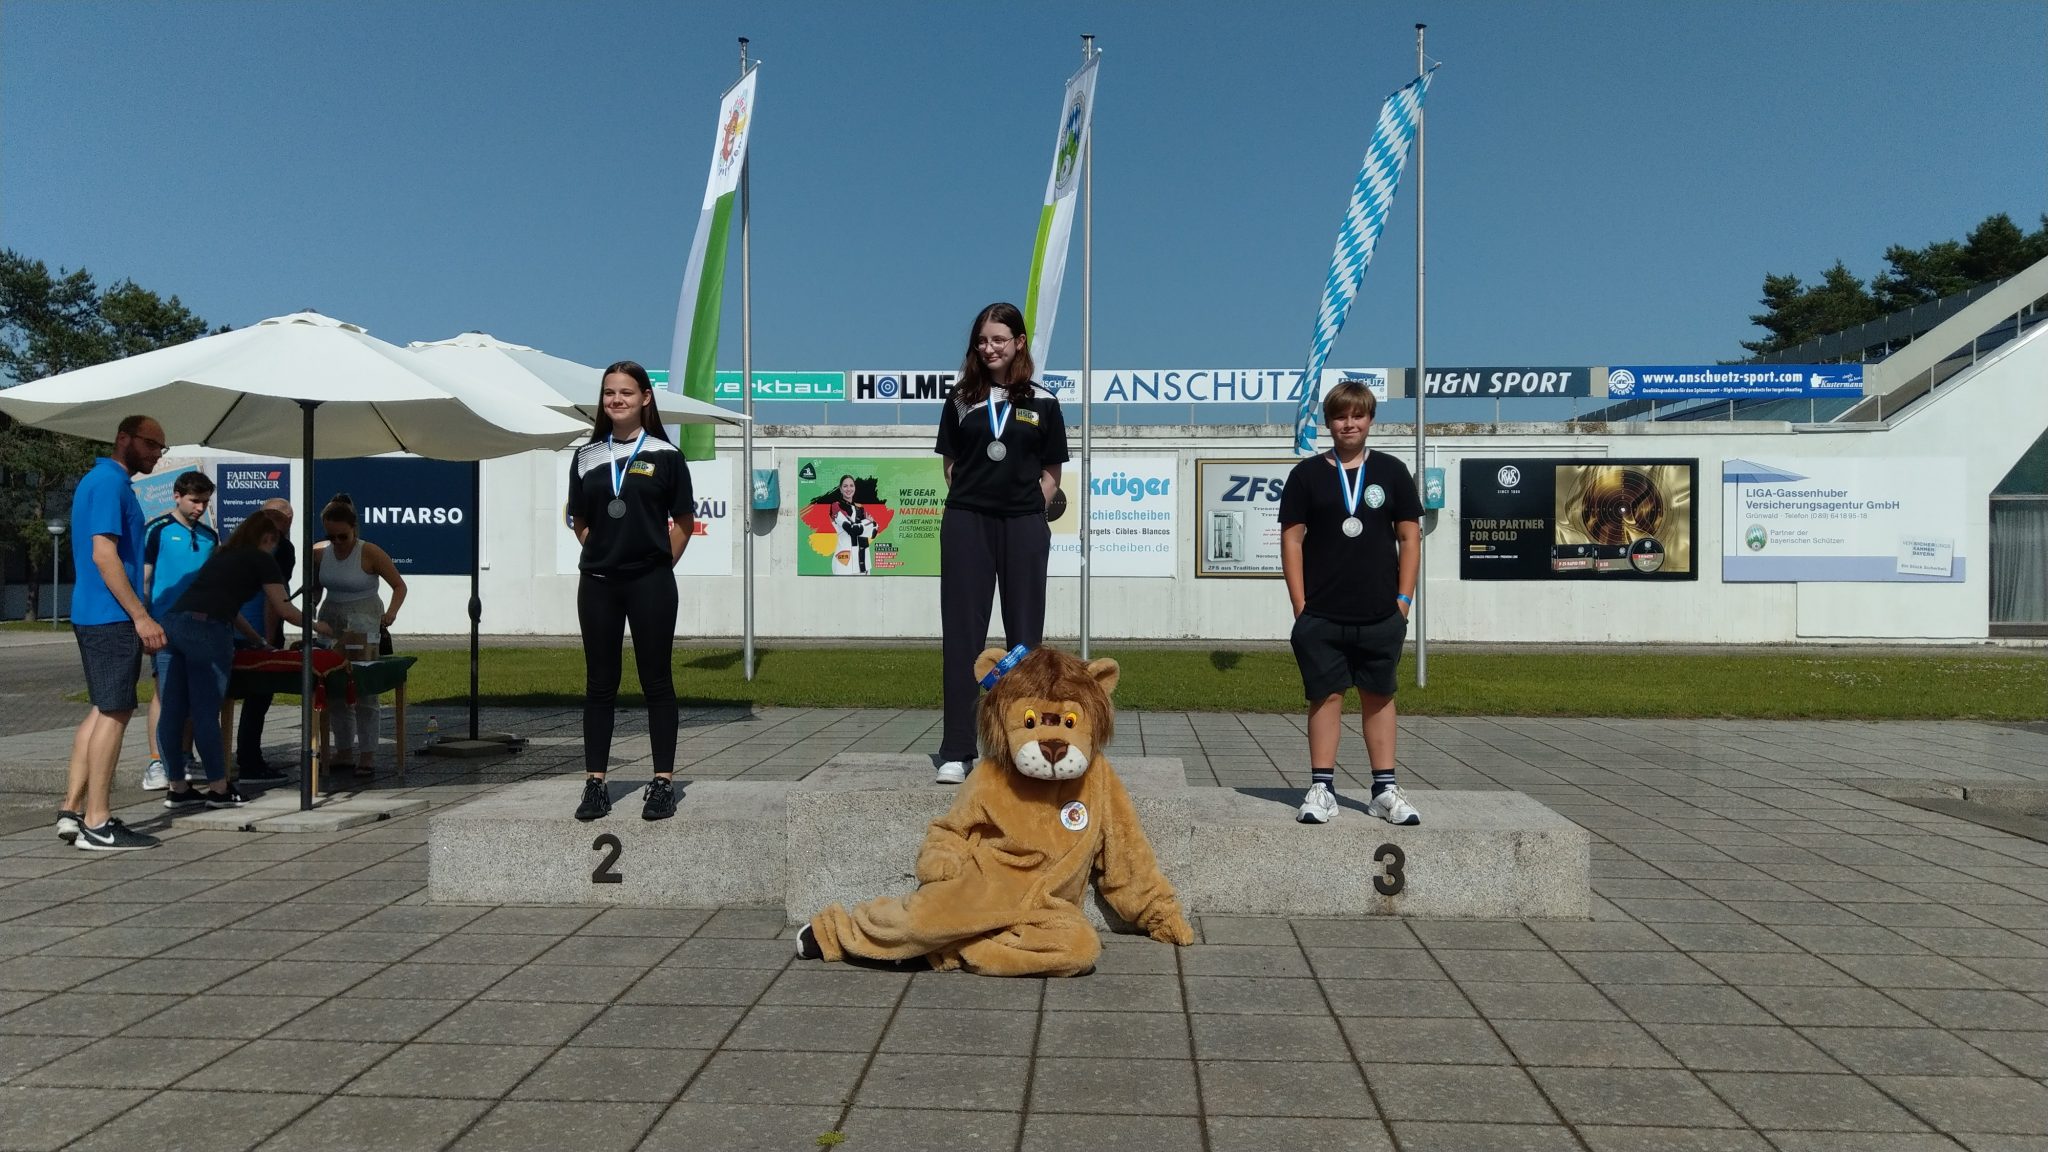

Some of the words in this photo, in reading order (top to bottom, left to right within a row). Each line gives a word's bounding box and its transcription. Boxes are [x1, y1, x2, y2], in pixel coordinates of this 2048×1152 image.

[1642, 369, 1803, 386] www.anschuetz-sport.com
[1425, 373, 1480, 394] H&N
[1488, 372, 1572, 393] SPORT
[227, 471, 267, 480] FAHNEN
[227, 478, 280, 489] KÖSSINGER
[1090, 472, 1170, 502] krüger
[1746, 488, 1848, 498] LIGA-Gassenhuber
[1746, 501, 1864, 511] Versicherungsagentur
[1866, 501, 1900, 509] GmbH
[364, 507, 463, 524] INTARSO
[1090, 510, 1170, 520] chießscheiben
[1470, 520, 1497, 529] YOUR
[1500, 520, 1544, 529] PARTNER
[1090, 528, 1111, 536] argets
[1470, 531, 1489, 540] FOR
[1491, 531, 1517, 540] GOLD
[1050, 543, 1169, 553] kruegr-scheiben.de
[592, 833, 622, 883] 2
[1373, 843, 1405, 896] 3
